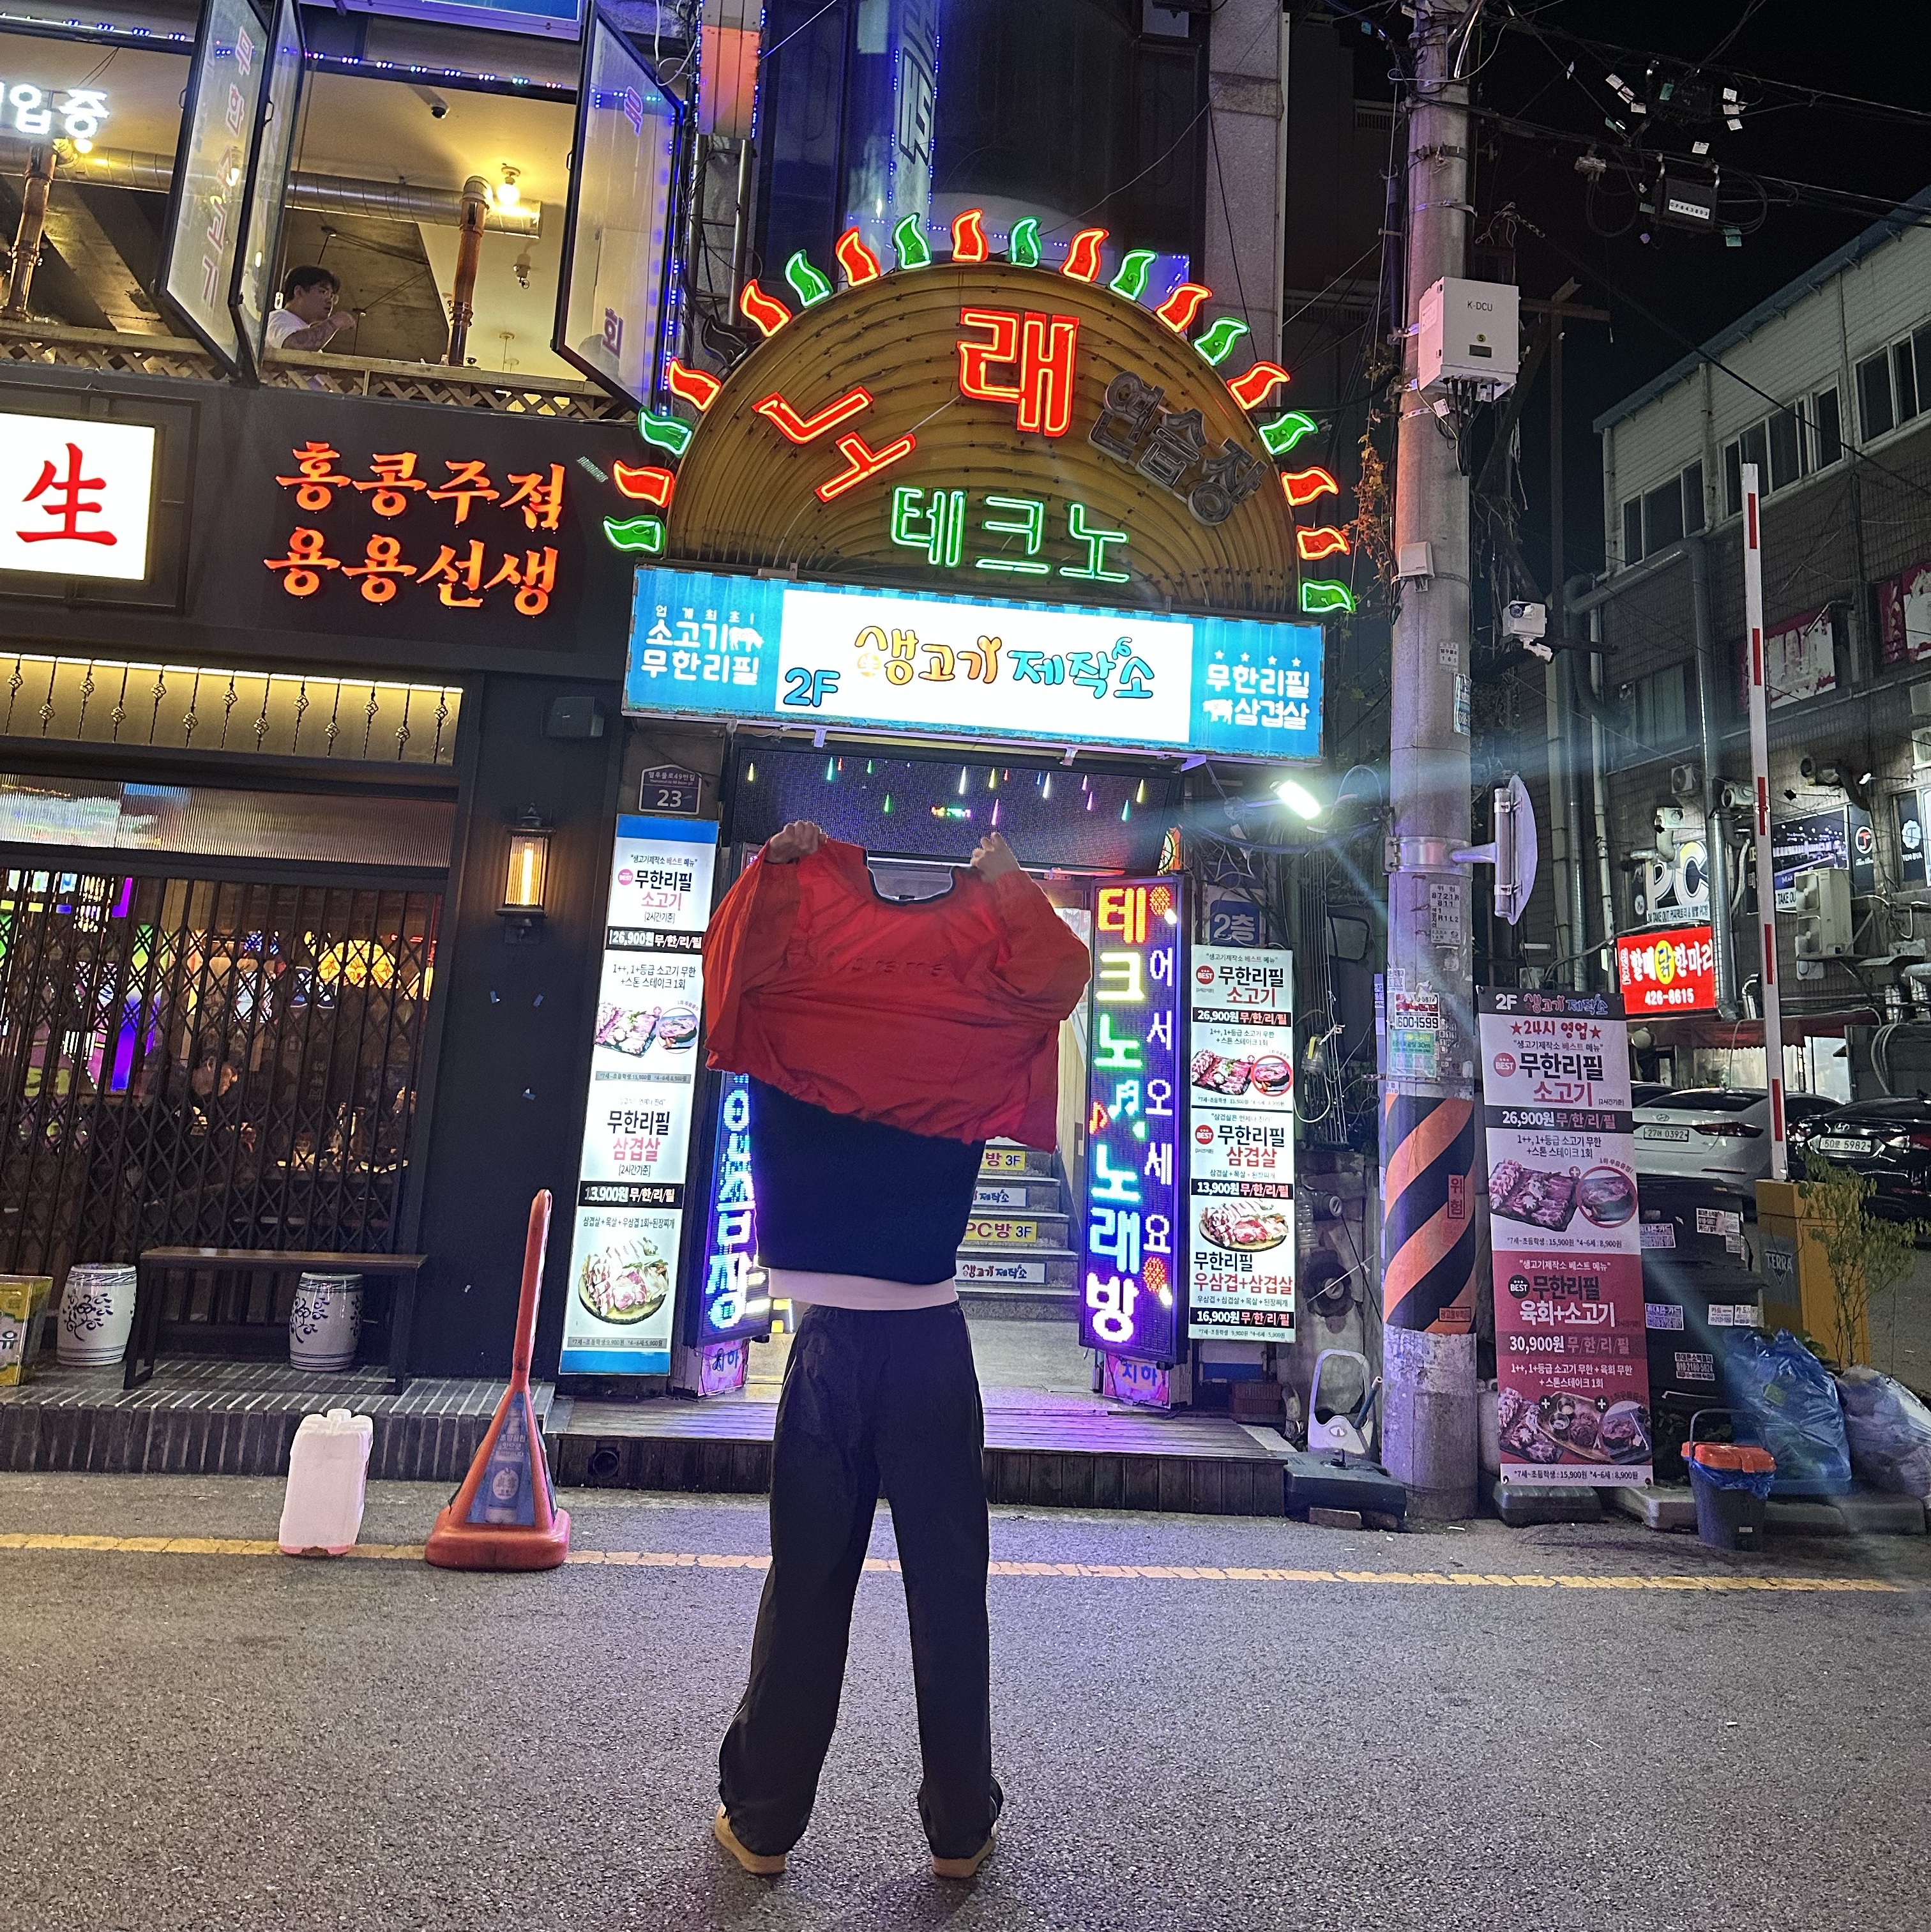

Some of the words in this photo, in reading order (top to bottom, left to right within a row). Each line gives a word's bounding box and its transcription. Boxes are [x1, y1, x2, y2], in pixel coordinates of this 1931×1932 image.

[0, 80, 110, 139] 업중
[1467, 300, 1493, 312] K-DCU
[1087, 370, 1268, 526] 연습장
[16, 443, 118, 547] 生
[275, 440, 565, 531] 홍콩주점
[890, 485, 1130, 582] 테크노
[263, 526, 558, 618] 용용선생
[646, 619, 728, 653] 소고기
[640, 649, 760, 686] 무한리필
[854, 625, 1002, 686] 생고기
[1007, 636, 1155, 699] 제작소
[783, 667, 841, 708] 2F
[1206, 664, 1310, 699] 무한리필
[1234, 697, 1310, 731] 삼겹살
[656, 789, 682, 807] 23
[634, 869, 693, 892] 무한리필
[1645, 840, 1709, 915] PC
[640, 892, 682, 911] 소고기
[1213, 914, 1255, 941] 2층
[642, 978, 672, 989] 스테이크
[656, 966, 679, 977] 소고기
[681, 966, 696, 978] 무한
[1093, 886, 1147, 1071] 테크노
[1218, 966, 1284, 988] 무한리필
[1226, 987, 1276, 1007] 소고기
[1495, 993, 1518, 1011] 2F
[1523, 993, 1566, 1014] 생고기
[1566, 993, 1609, 1015] 제작소
[1644, 987, 1695, 1006] 426-8615
[1197, 1010, 1239, 1023] 26,900원
[1239, 1012, 1287, 1025] 무/한/리/필
[1523, 1020, 1556, 1036] 24시
[1561, 1022, 1589, 1040] 영업
[1496, 1061, 1514, 1071] BEST
[1519, 1053, 1605, 1081] 무한리필
[1143, 947, 1174, 1254] 어서오세요
[1533, 1081, 1593, 1107] 소고기
[607, 1110, 670, 1136] 무한리필
[1502, 1111, 1555, 1128] 26,900원
[1556, 1112, 1617, 1130] 무/한/리/필
[1218, 1125, 1285, 1148] 무한리필
[1536, 1135, 1560, 1146] 1+등급
[1562, 1136, 1585, 1147] 소고기
[1586, 1137, 1602, 1148] 무한
[1665, 1130, 1684, 1139] 0392
[1844, 1141, 1867, 1150] 5982
[613, 1137, 661, 1162] 삼겹살
[1005, 1155, 1021, 1166] 3F
[1226, 1146, 1278, 1168] 삼겹살
[1549, 1148, 1580, 1159] 스테이크
[1197, 1182, 1239, 1196] 13,900원
[1240, 1183, 1289, 1198] 무/한/리/필
[1450, 1178, 1463, 1215] 위험
[1015, 1226, 1032, 1238] 3F
[1085, 1143, 1142, 1344] 노래방
[1193, 1252, 1253, 1272] 무한리필
[1765, 1253, 1794, 1274] TERRA
[1193, 1272, 1293, 1295] 우삼겹+삼겹살
[1510, 1283, 1528, 1292] BEST
[1533, 1275, 1601, 1301] 무한리필
[1197, 1311, 1240, 1325] 16,900원
[1241, 1312, 1290, 1327] 무/한/리/필
[1520, 1300, 1616, 1328] 육회+소고기
[1509, 1335, 1565, 1355] 30,900원
[1122, 1362, 1158, 1387] 지하
[1554, 1364, 1577, 1374] 소고기
